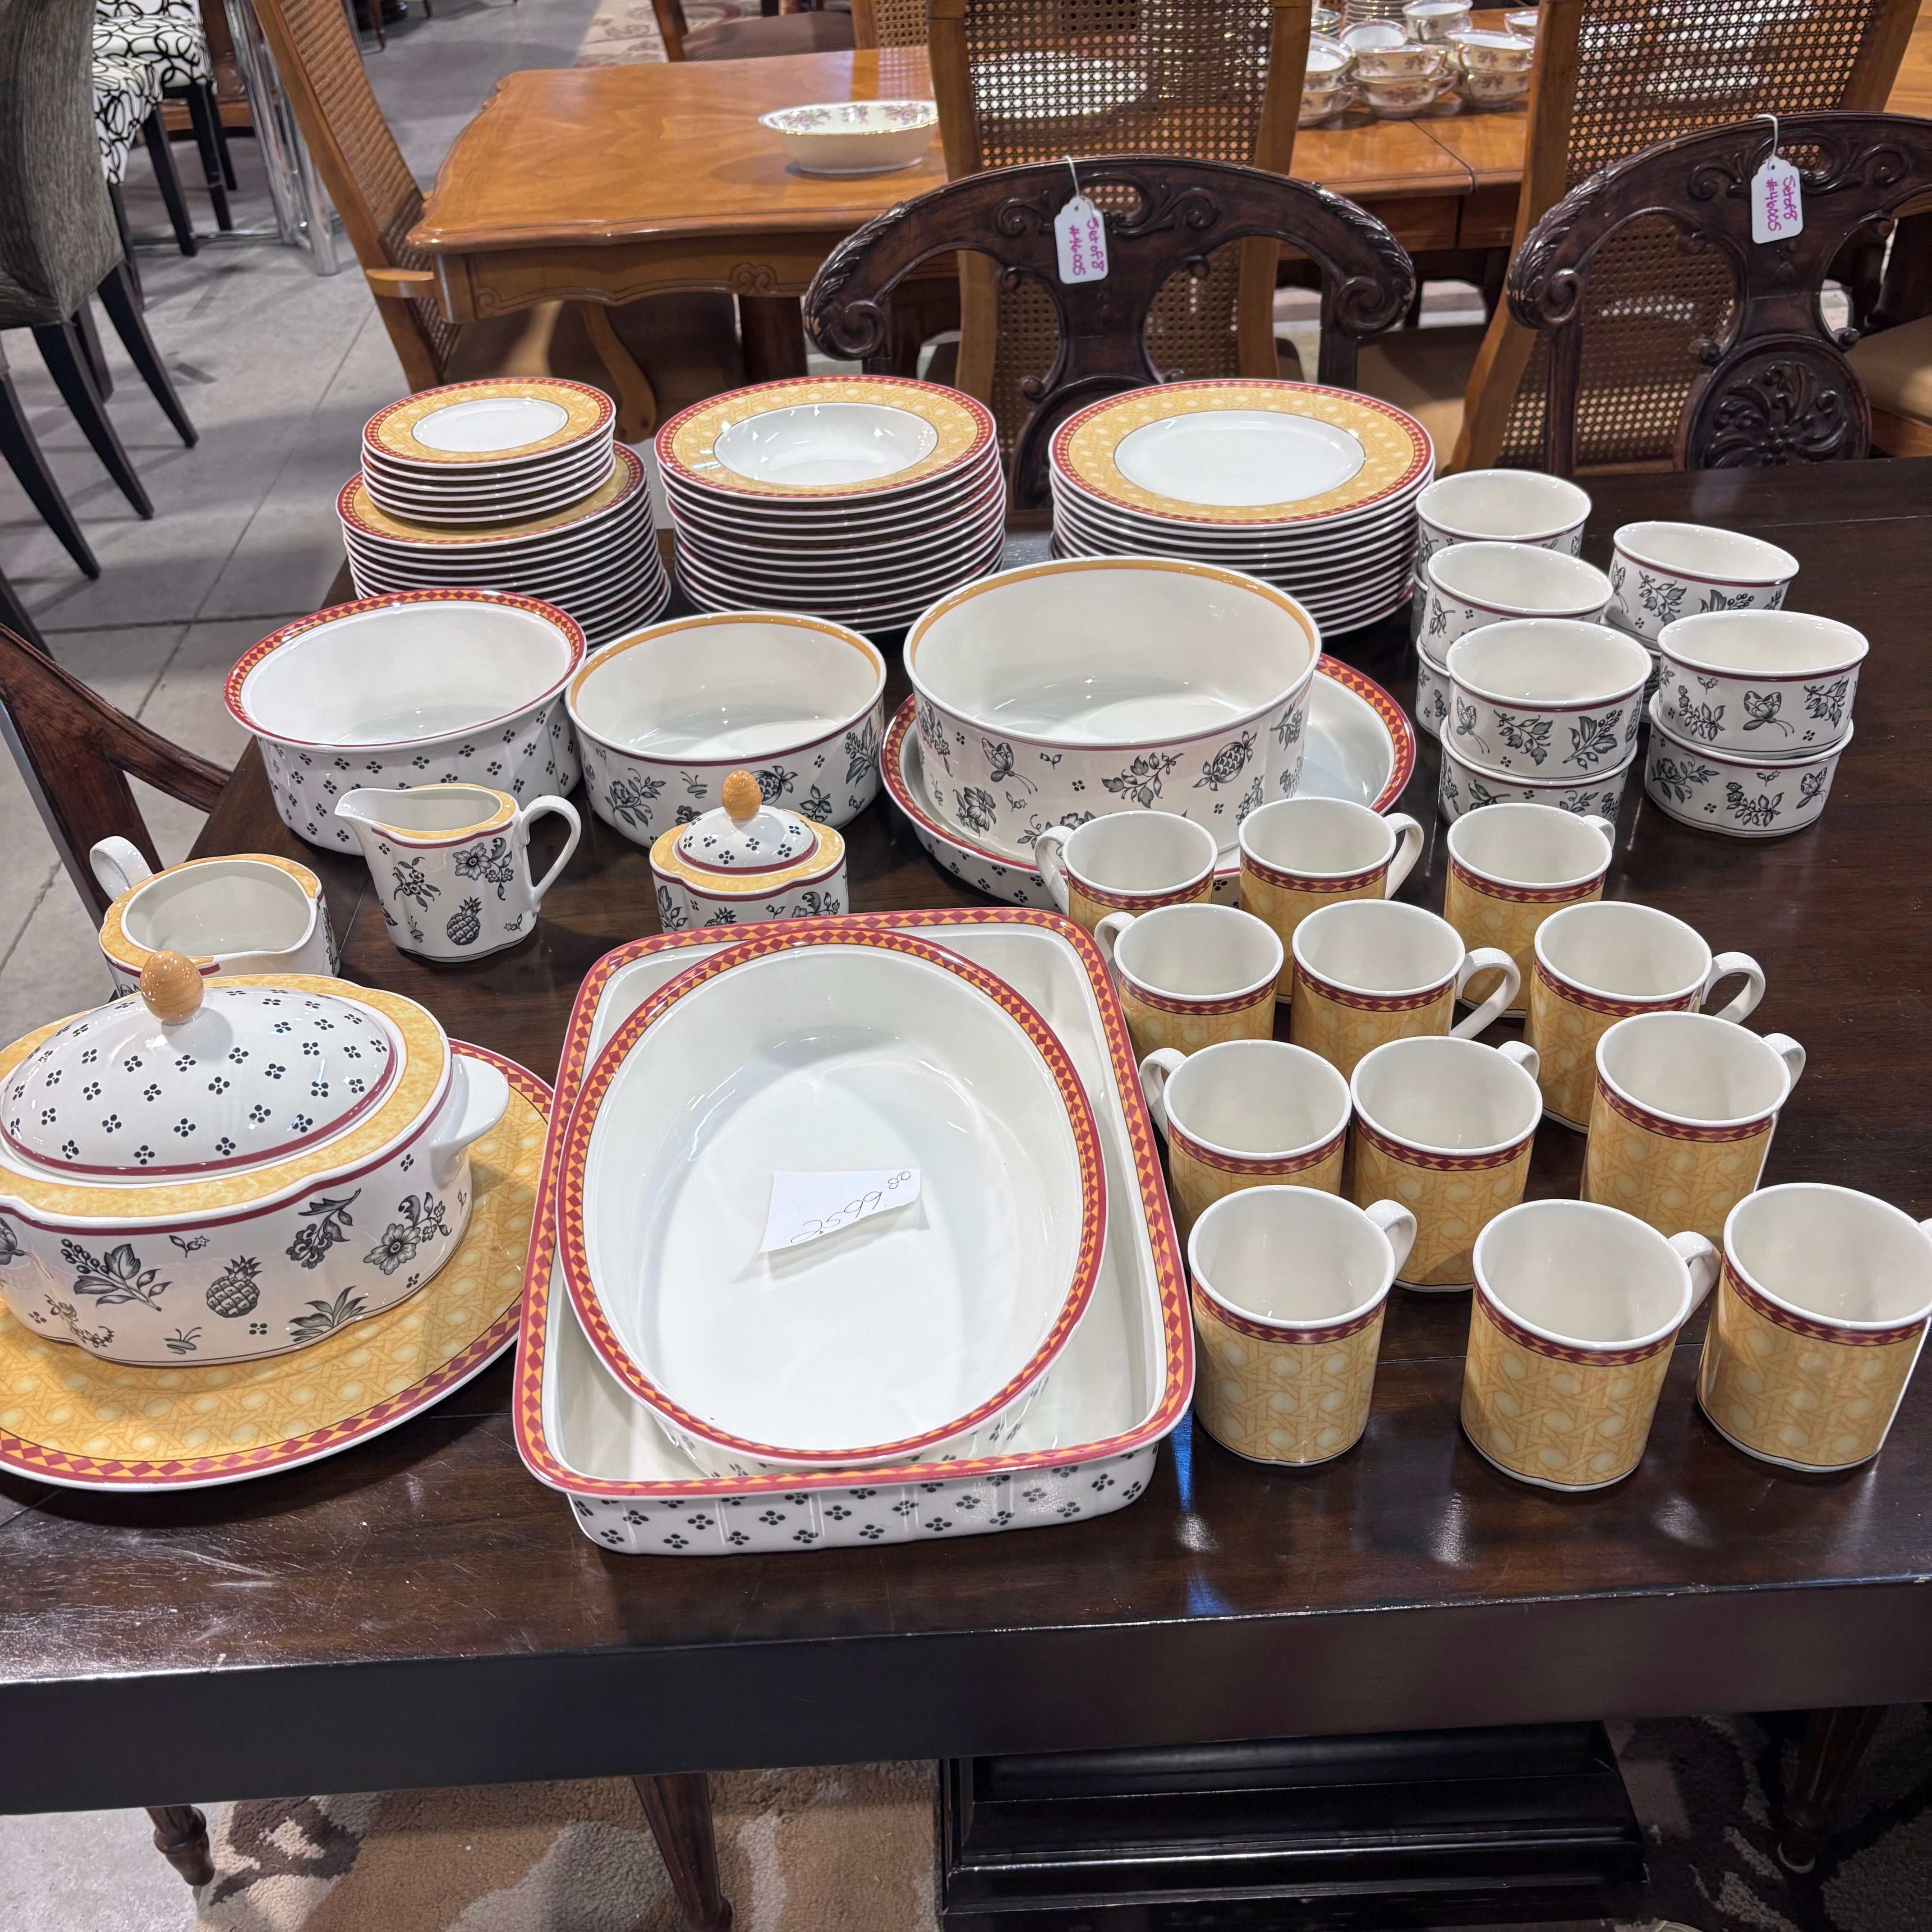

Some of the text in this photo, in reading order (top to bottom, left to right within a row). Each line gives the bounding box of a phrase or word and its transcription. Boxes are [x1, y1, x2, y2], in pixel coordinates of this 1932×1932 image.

[1765, 178, 1782, 231] #46005
[1783, 175, 1795, 197] Set
[1783, 211, 1798, 221] 8
[1068, 225, 1086, 276] #46005
[1086, 217, 1105, 271] Set of 8
